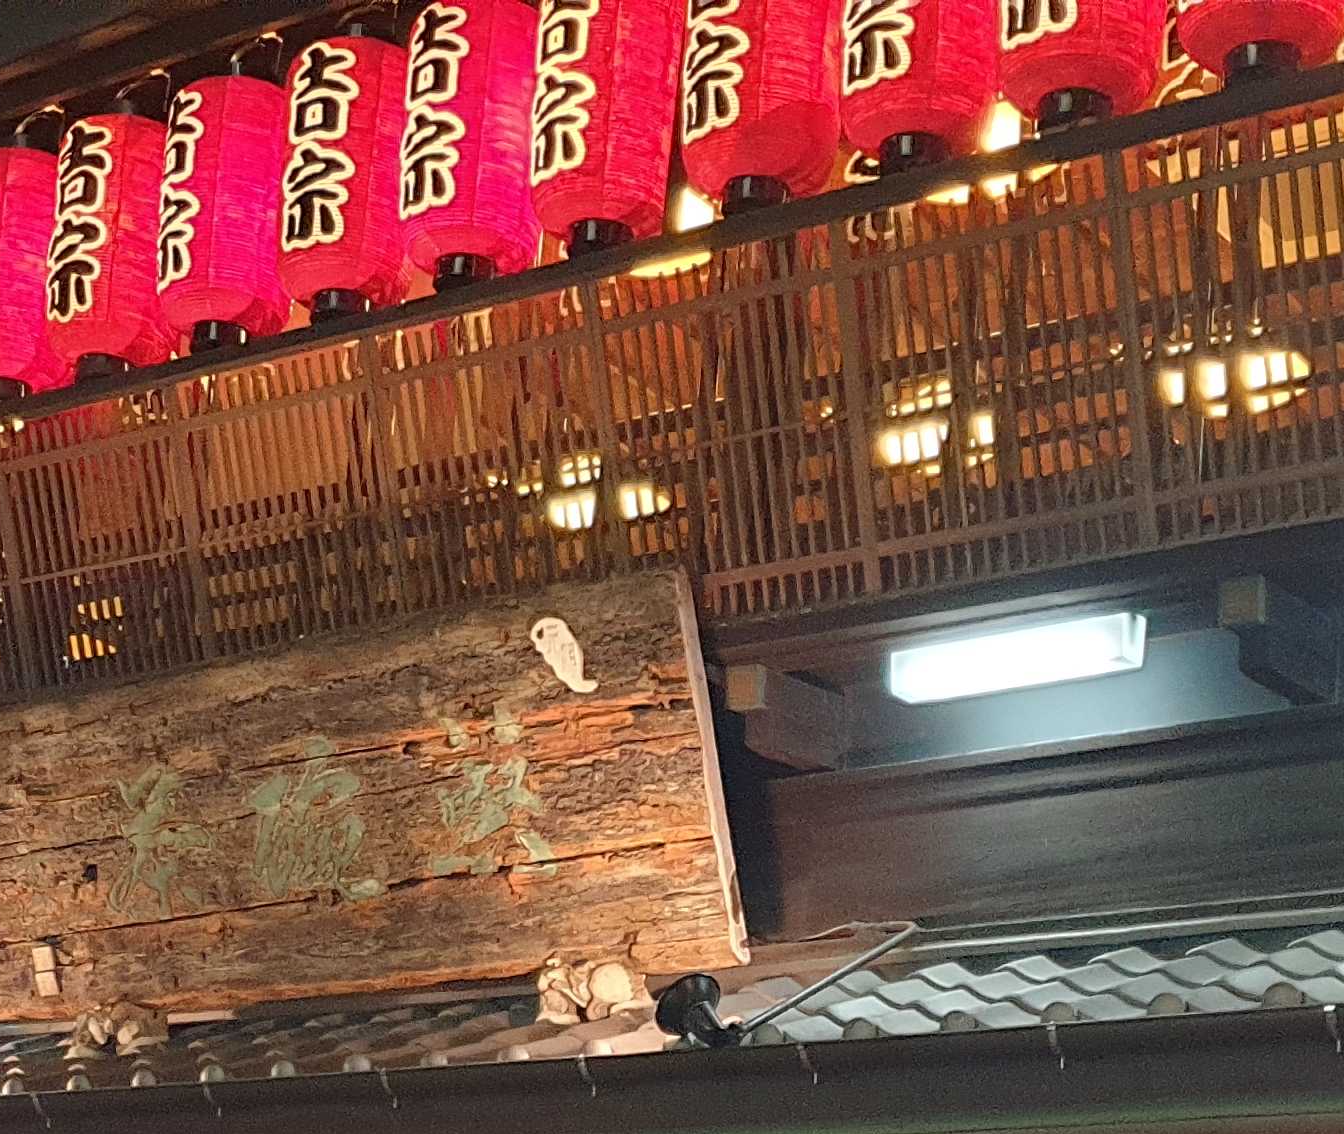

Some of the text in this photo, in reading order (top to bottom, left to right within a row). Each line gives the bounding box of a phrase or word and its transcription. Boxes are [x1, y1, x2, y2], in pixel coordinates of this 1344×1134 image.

[281, 41, 360, 252] 吉宗
[399, 2, 469, 221] 吉宗
[47, 120, 112, 323] 吉宗
